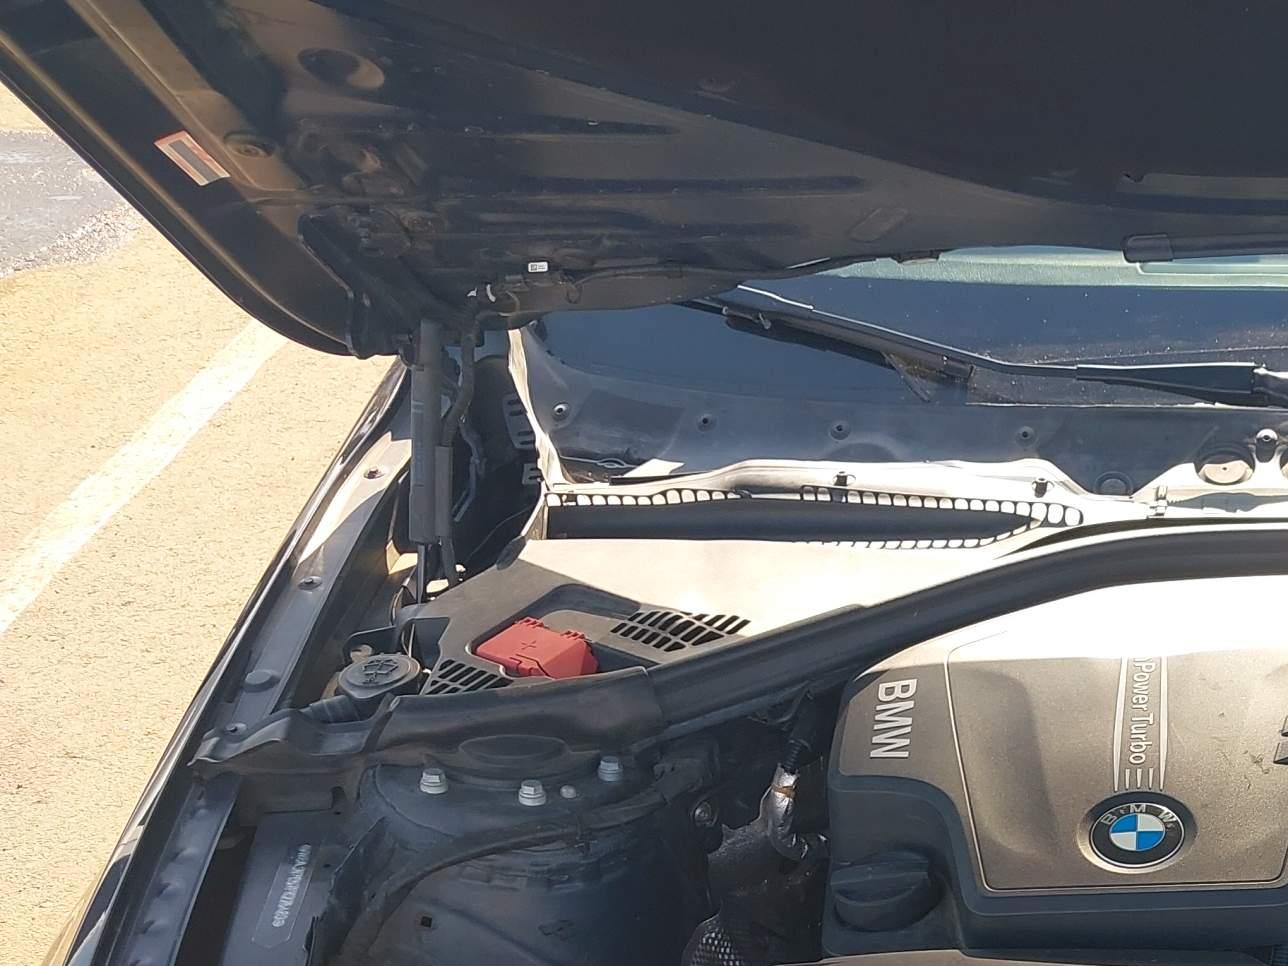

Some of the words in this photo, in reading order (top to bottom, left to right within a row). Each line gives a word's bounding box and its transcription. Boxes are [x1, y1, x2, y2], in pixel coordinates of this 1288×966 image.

[870, 678, 917, 759] BMW
[1129, 712, 1154, 765] Turbo
[1100, 803, 1177, 826] BMW
